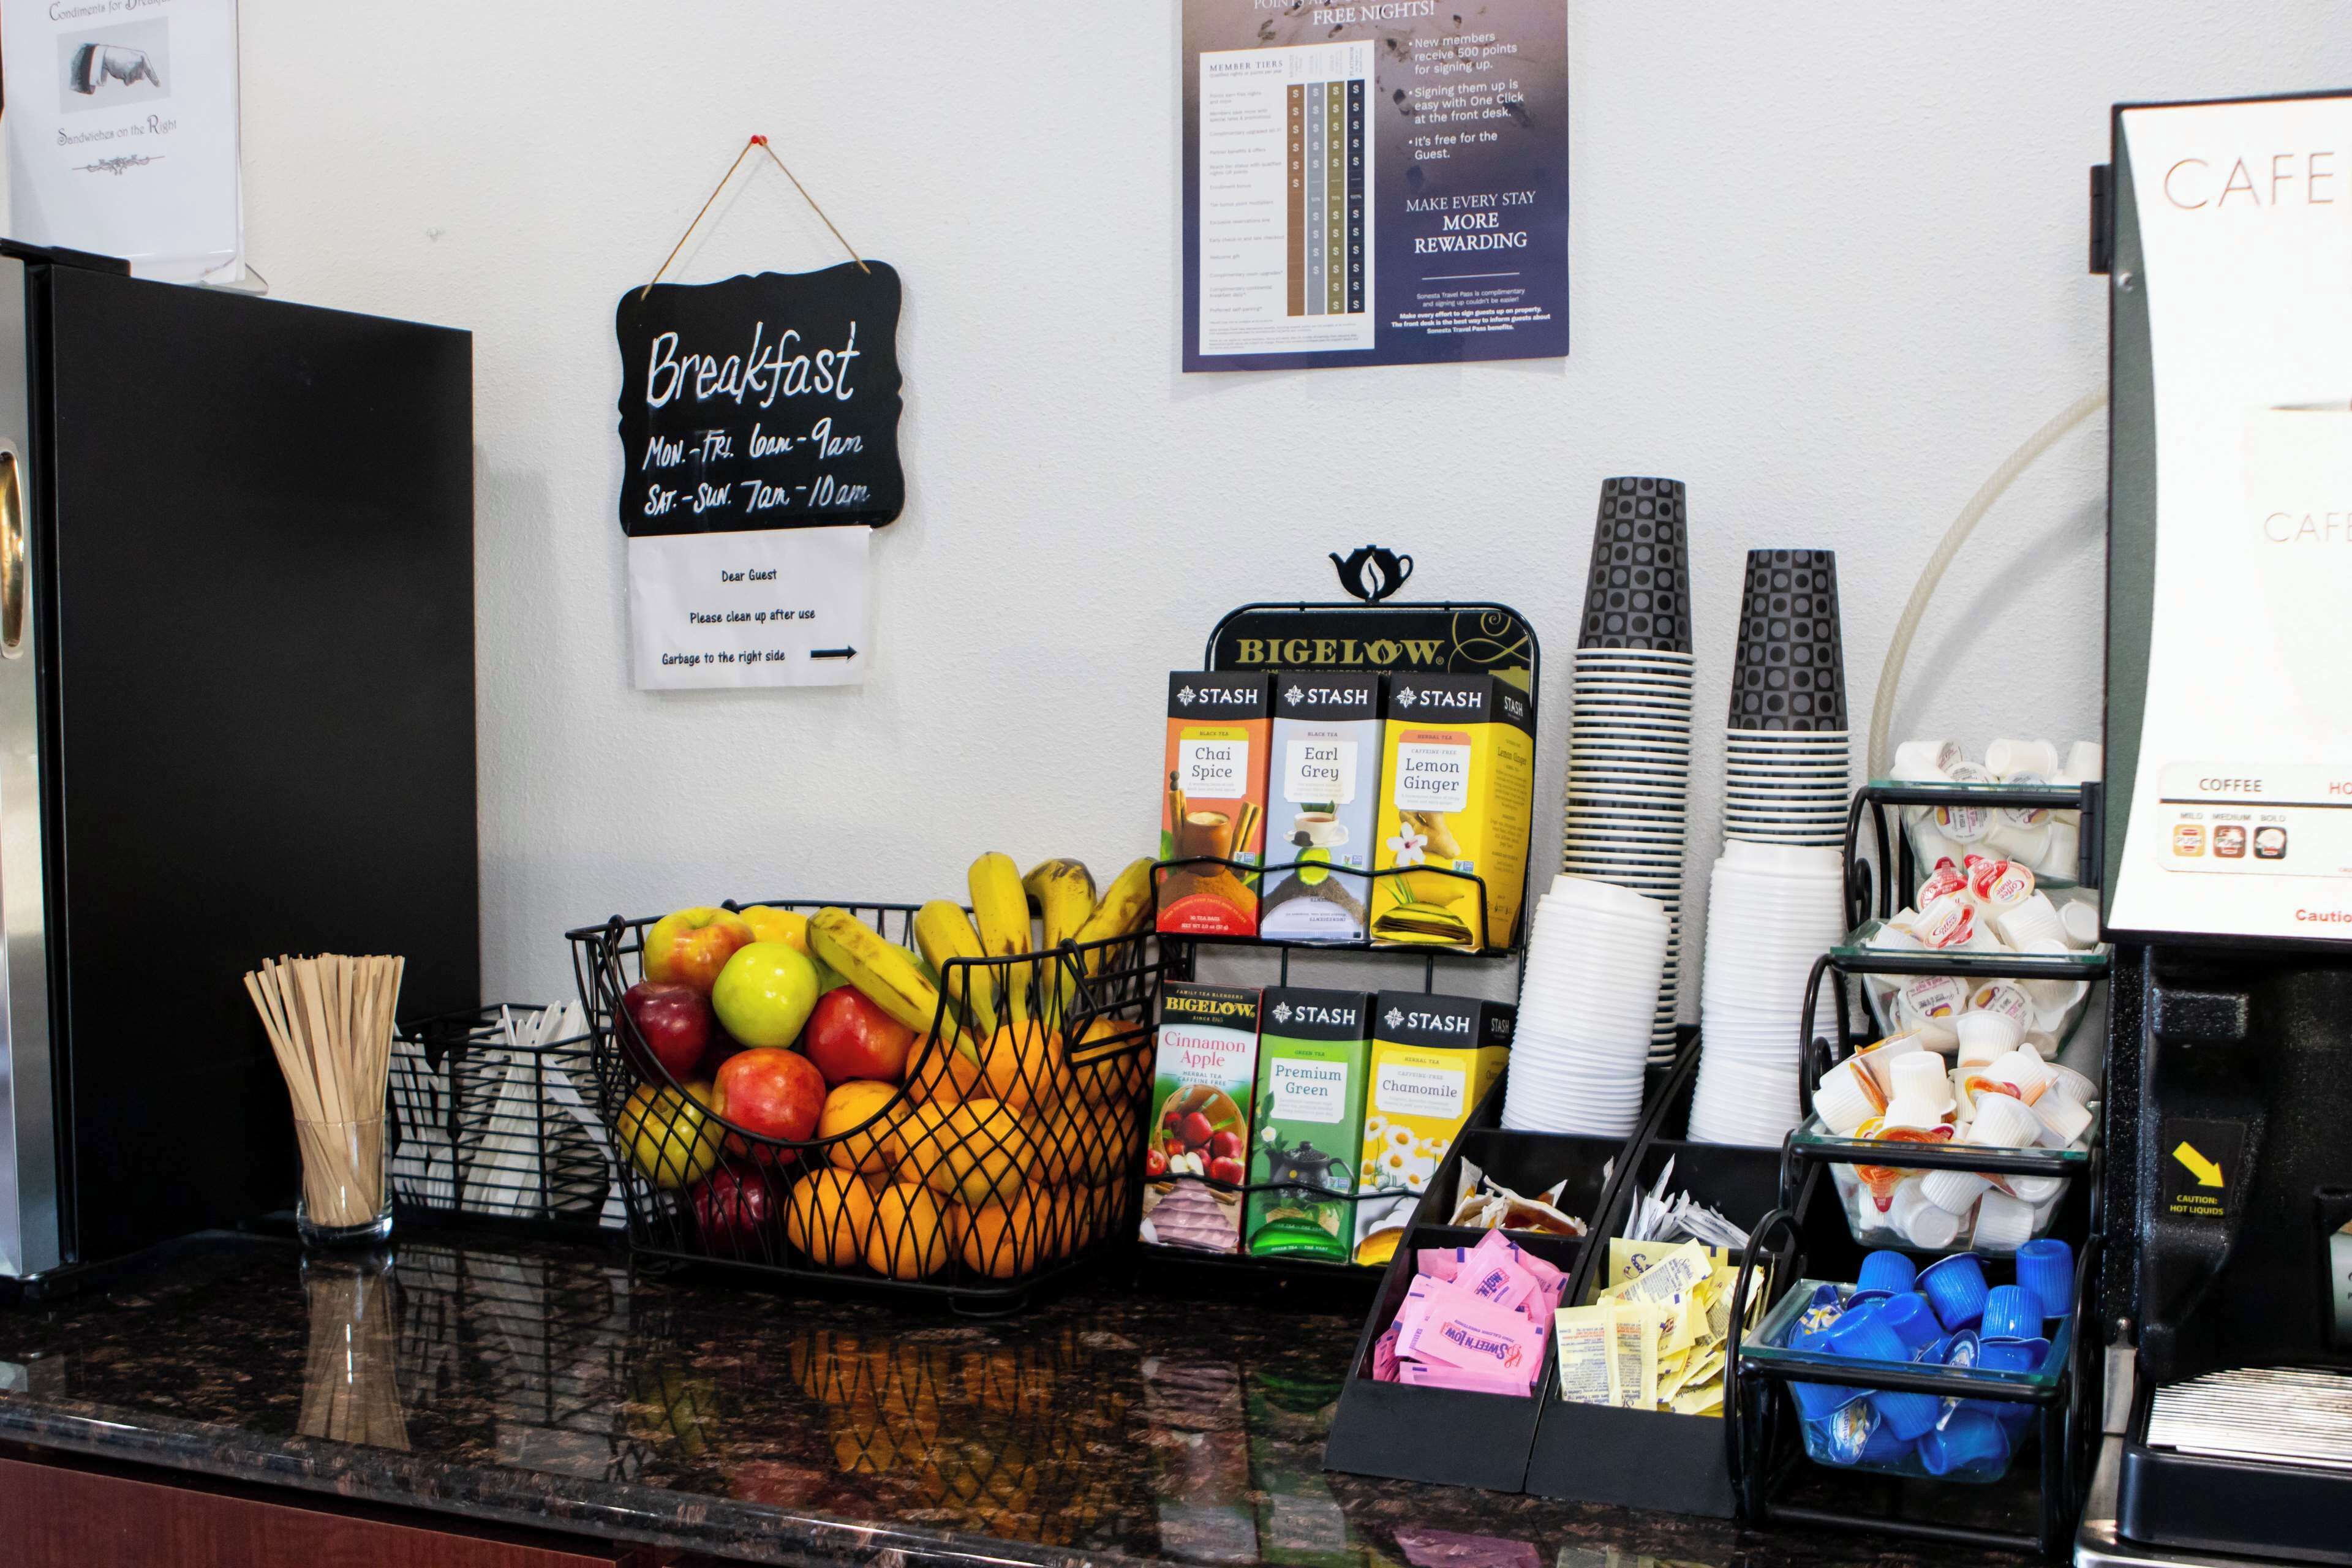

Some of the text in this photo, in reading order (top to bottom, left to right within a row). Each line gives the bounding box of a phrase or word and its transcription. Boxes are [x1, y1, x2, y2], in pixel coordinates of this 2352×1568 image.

[108, 2, 122, 13] for
[1313, 1, 1434, 25] FREE NIGHTS!
[1415, 33, 1496, 48] New members
[1414, 43, 1518, 61] receive 500 points
[1210, 60, 1283, 72] MEMBER TIERS
[1415, 61, 1493, 75] for signing up.
[1414, 78, 1518, 99] Signing them up is
[1415, 92, 1525, 112] easy with One Click
[1415, 107, 1512, 124] at the front desk.
[58, 115, 177, 146] Sandwiches on the Right
[1414, 130, 1498, 147] It's free for the
[1414, 149, 1450, 160] Guest.
[2163, 151, 2335, 210] CAFE
[1406, 190, 1536, 212] MAKE EVERY STAY
[1442, 212, 1499, 231] MORE
[1414, 232, 1528, 254] REWARDING
[646, 320, 861, 408] Breakfast
[722, 568, 777, 582] Dear Guest
[690, 608, 816, 624] Please clean up after use
[662, 649, 785, 667] Garbage to the right side
[1235, 638, 1445, 665] BIGELOW
[1199, 688, 1259, 704] STASH
[1306, 688, 1369, 704] STASH
[1420, 690, 1482, 708] STASH
[1504, 695, 1524, 717] STASH
[1195, 747, 1231, 761] Chai
[1305, 747, 1338, 761] Earl
[1497, 746, 1527, 766] Lemon Ginger
[1191, 764, 1233, 781] Spice
[1301, 765, 1340, 781] Grey
[1406, 758, 1460, 773] Lemon
[1404, 775, 1460, 793] Ginger
[2199, 778, 2263, 792] COFFEE
[2000, 880, 2025, 899] Coffee
[1165, 997, 1256, 1017] BIGELOW
[1295, 1006, 1356, 1025] STASH
[1407, 1012, 1470, 1033] STASH
[1491, 1017, 1510, 1033] STASH
[1165, 1031, 1246, 1053] Cinnamon
[1180, 1050, 1225, 1069] Apple
[1275, 1065, 1341, 1081] Premium
[1286, 1082, 1329, 1096] Green
[1382, 1079, 1458, 1098] Chamomile
[2176, 1194, 2218, 1204] CAUTION:
[2189, 1206, 2224, 1215] LIQUIDS
